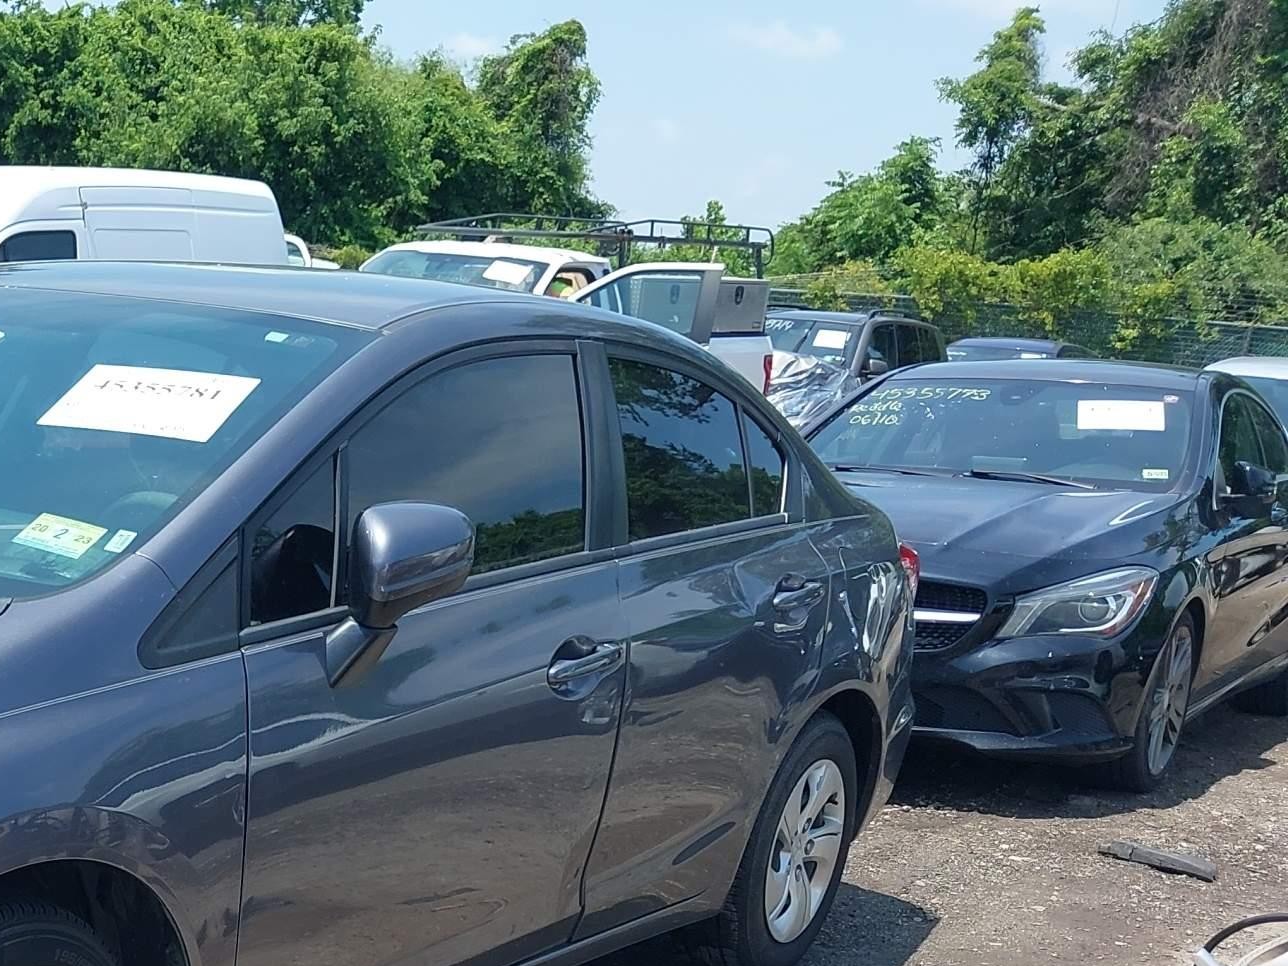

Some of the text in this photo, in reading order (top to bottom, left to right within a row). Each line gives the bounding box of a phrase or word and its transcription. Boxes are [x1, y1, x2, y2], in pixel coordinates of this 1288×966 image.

[94, 379, 221, 400] 45355781
[32, 523, 93, 545] 20 2 23
